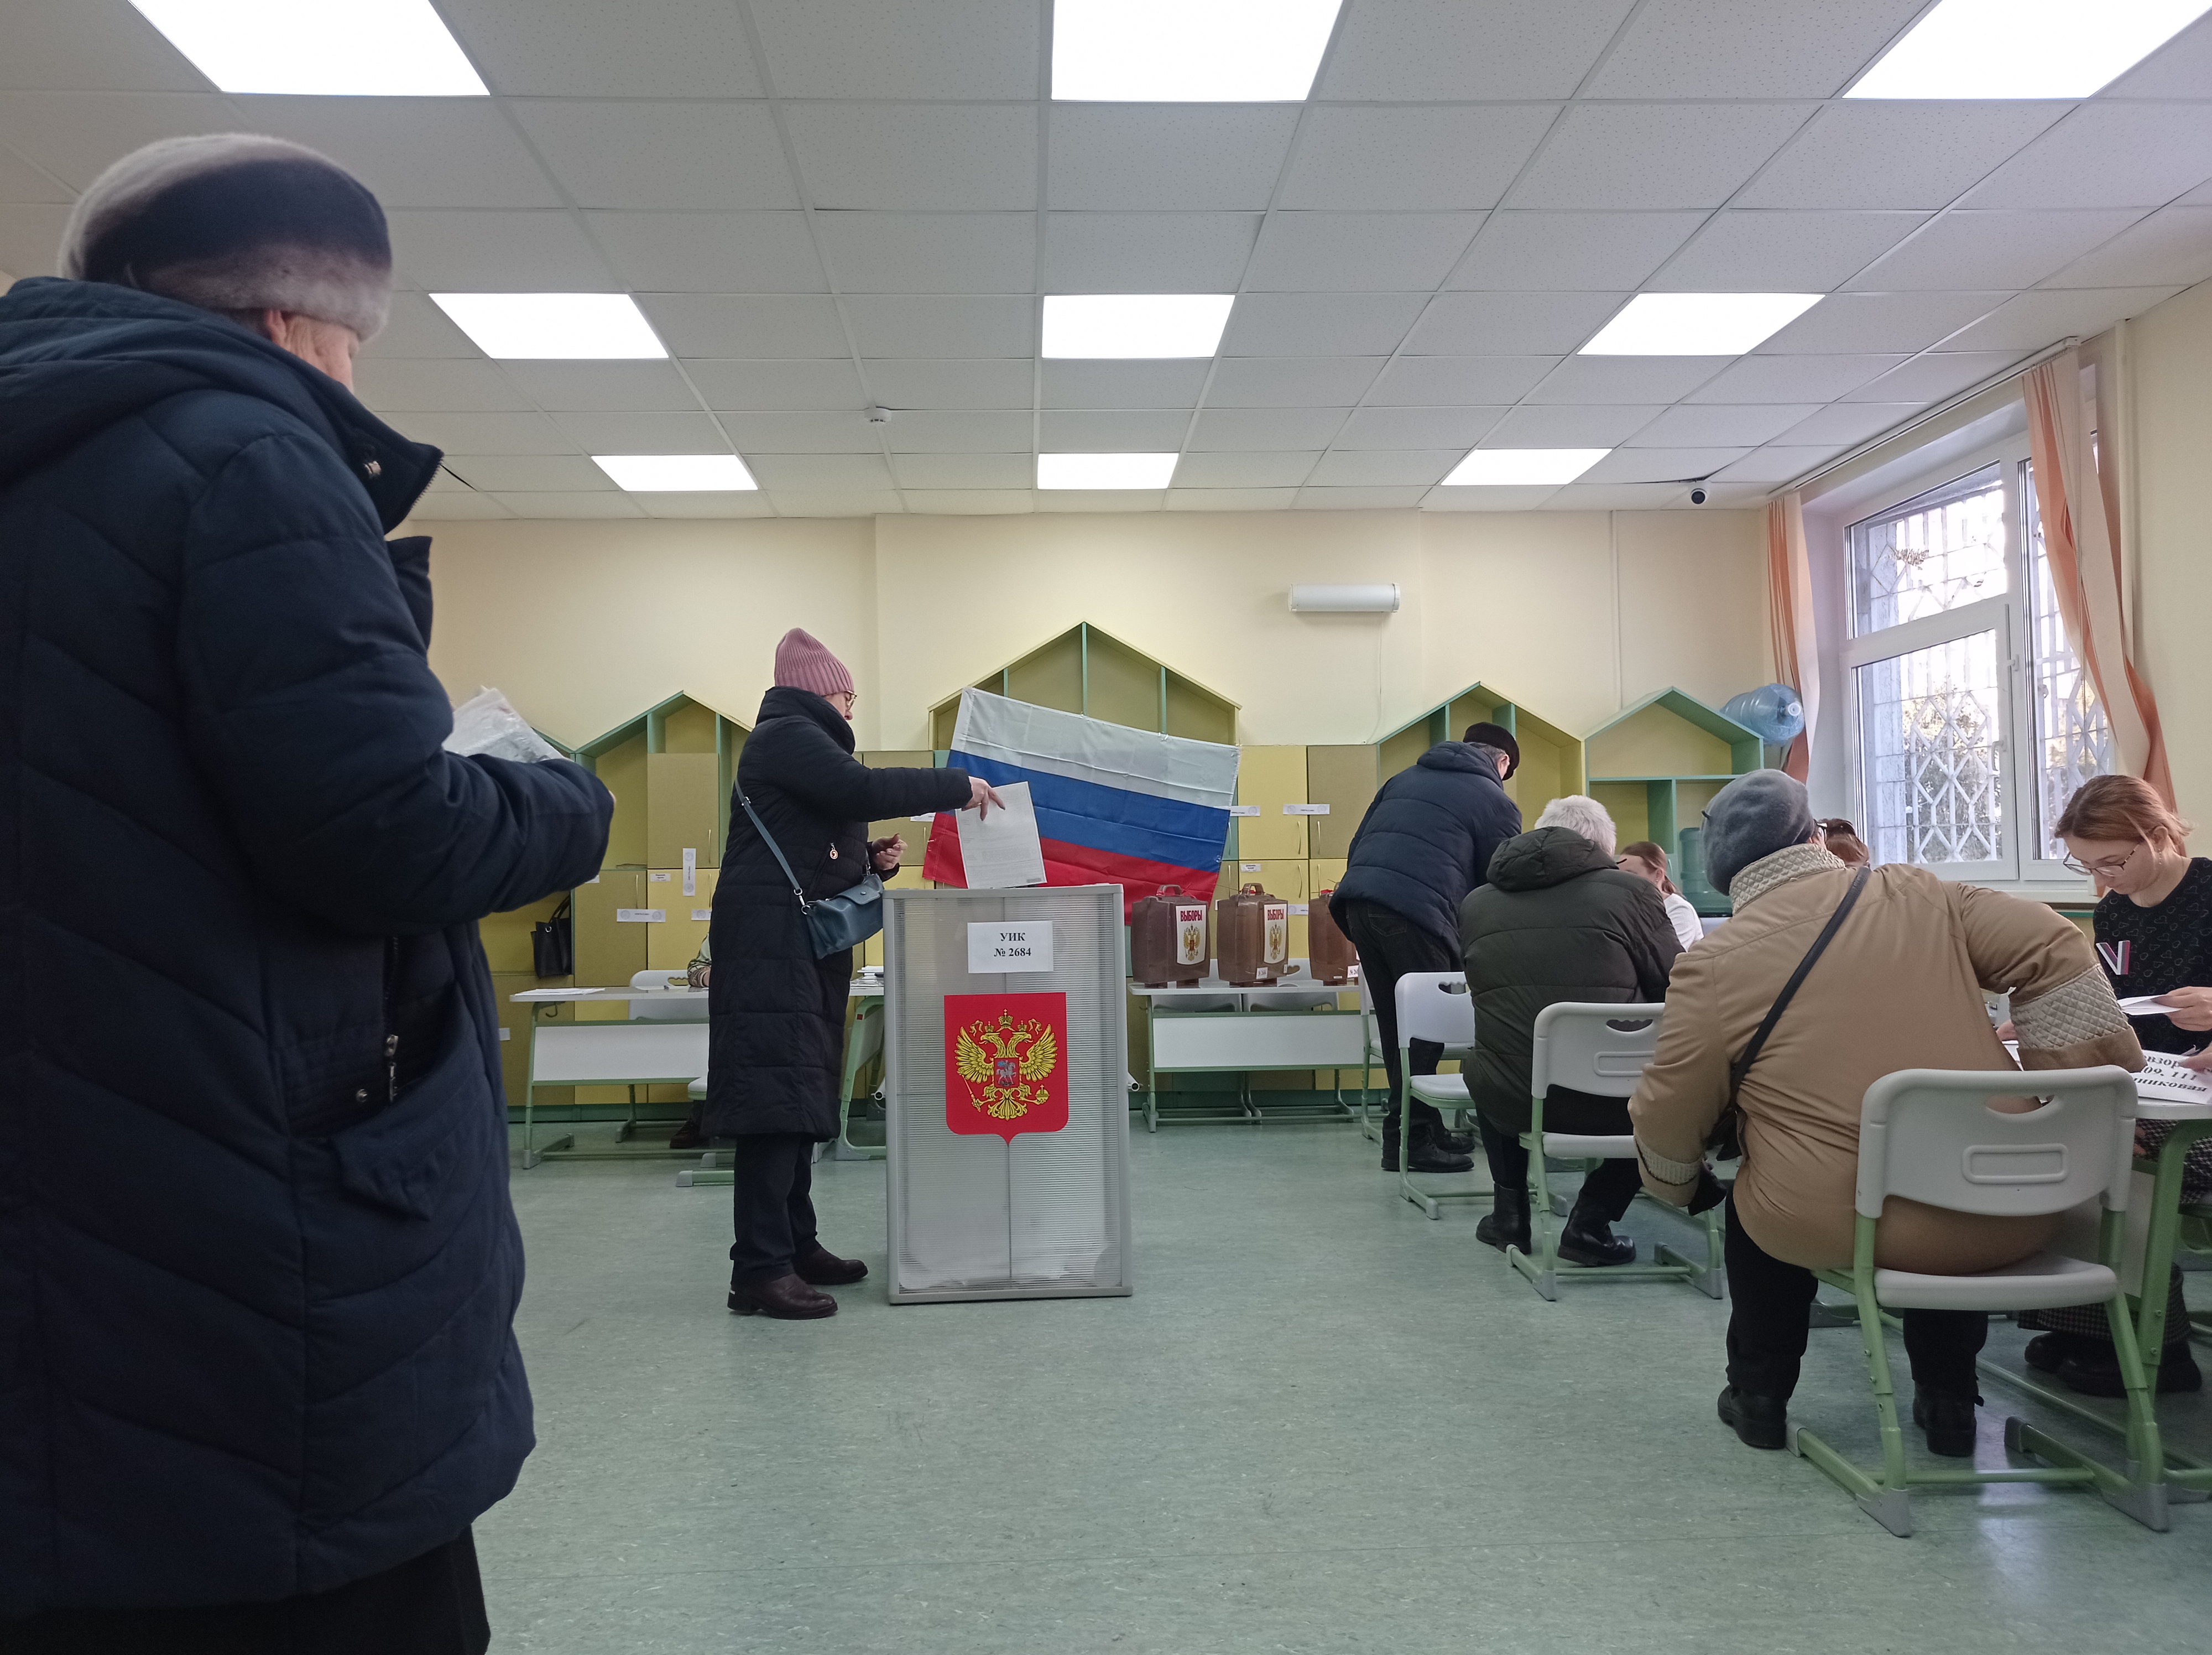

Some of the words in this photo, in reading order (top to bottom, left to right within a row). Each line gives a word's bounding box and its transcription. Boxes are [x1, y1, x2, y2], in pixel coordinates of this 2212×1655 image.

[1181, 910, 1202, 922] ВЫБОРЫ
[1267, 909, 1284, 920] ВЫБОРЫ
[1000, 933, 1025, 941] УИК
[994, 948, 1006, 957] №
[1008, 948, 1031, 956] 2684
[2145, 1055, 2180, 1069] взор
